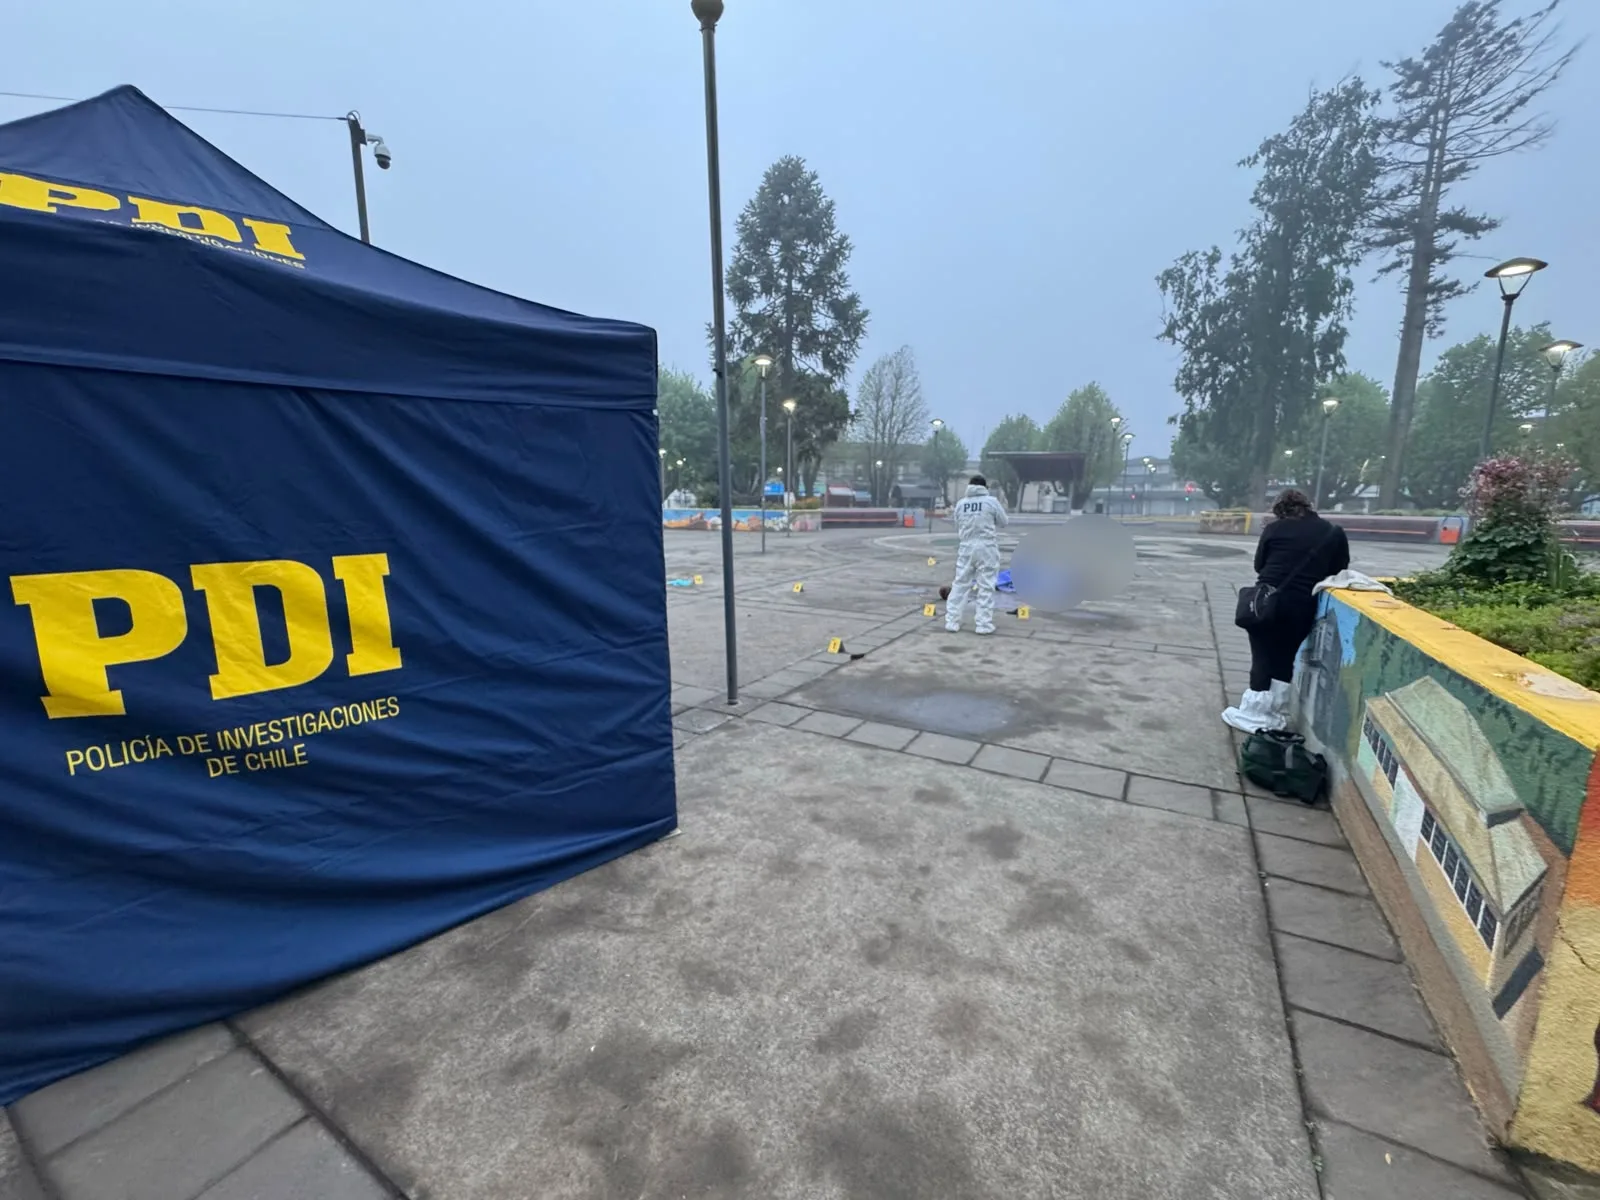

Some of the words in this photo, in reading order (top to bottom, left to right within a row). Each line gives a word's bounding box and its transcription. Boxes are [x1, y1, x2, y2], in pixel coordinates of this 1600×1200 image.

[0, 172, 306, 260] PDI
[963, 502, 982, 513] PDI
[10, 553, 402, 719] PDI
[66, 734, 174, 776] POLICÍA
[177, 733, 212, 755] DE
[216, 696, 400, 751] INVESTIGACIONES
[206, 755, 240, 778] DE
[245, 743, 309, 771] CHILE
